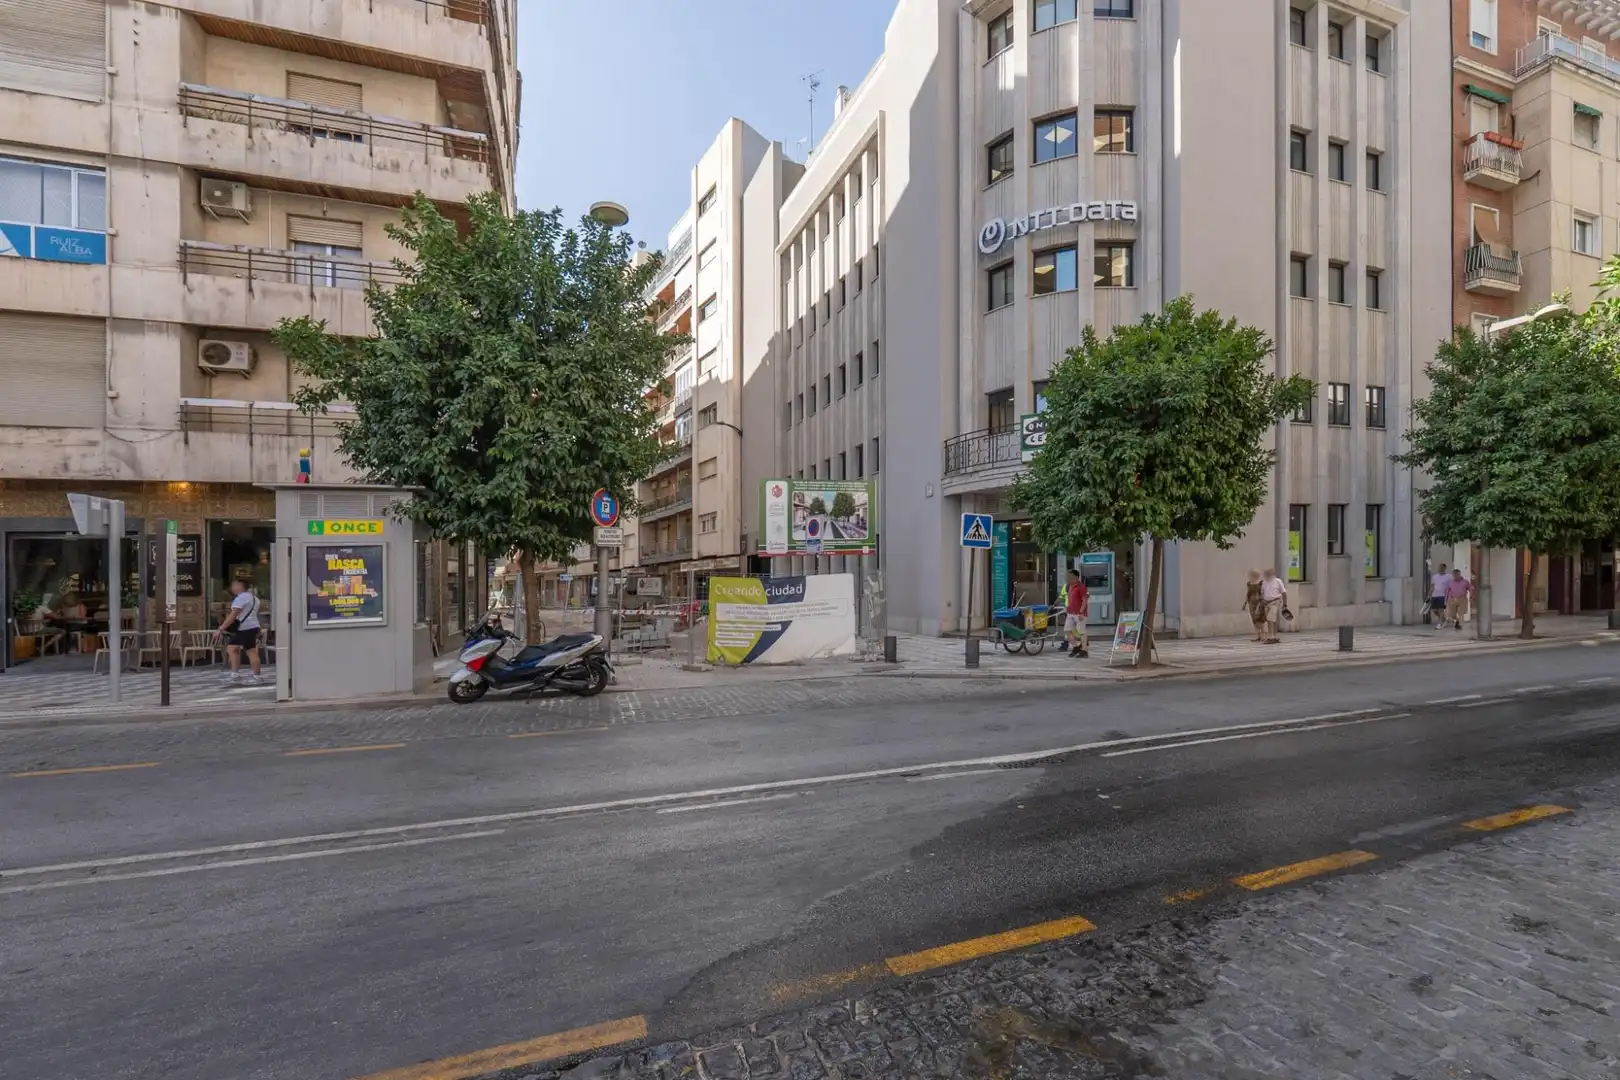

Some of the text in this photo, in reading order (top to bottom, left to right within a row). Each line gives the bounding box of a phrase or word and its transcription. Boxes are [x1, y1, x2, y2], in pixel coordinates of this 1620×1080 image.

[1012, 207, 1063, 238] NTT
[51, 236, 81, 246] RUIZ
[60, 244, 92, 255] ALBA
[330, 522, 377, 533] ONCE
[327, 558, 365, 570] RASCA
[765, 584, 803, 597] ciudad
